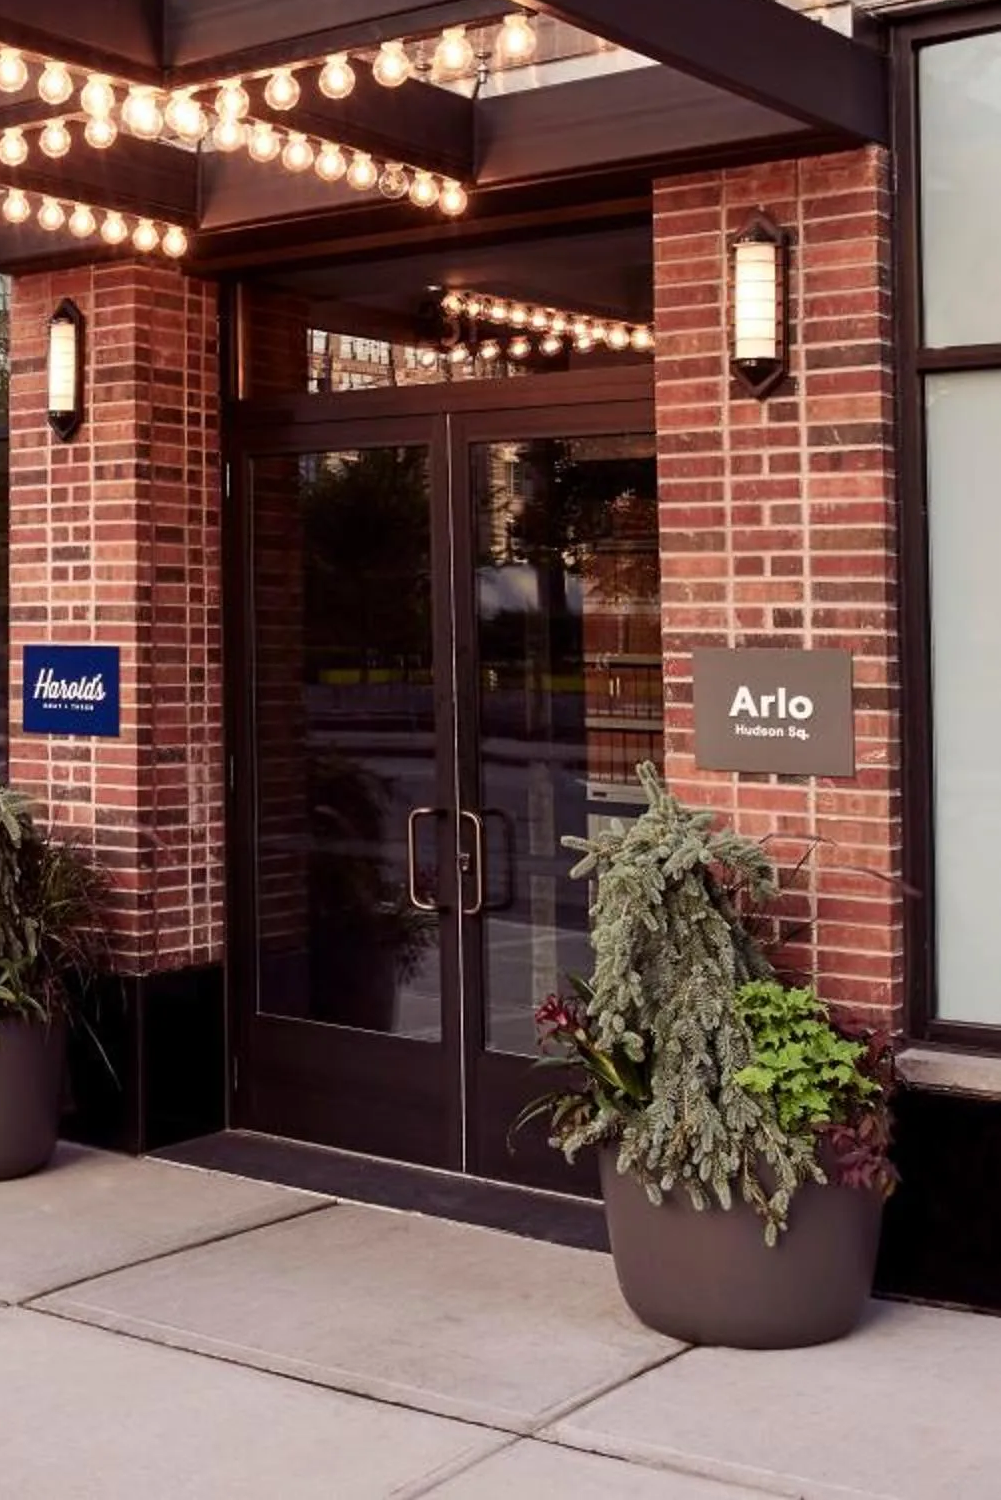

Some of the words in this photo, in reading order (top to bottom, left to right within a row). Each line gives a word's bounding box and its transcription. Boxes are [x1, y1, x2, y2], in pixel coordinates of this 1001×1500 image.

[33, 667, 107, 701] Harold's
[728, 685, 814, 720] Arlo
[734, 723, 784, 738] Hudson
[788, 725, 811, 741] Sq.
